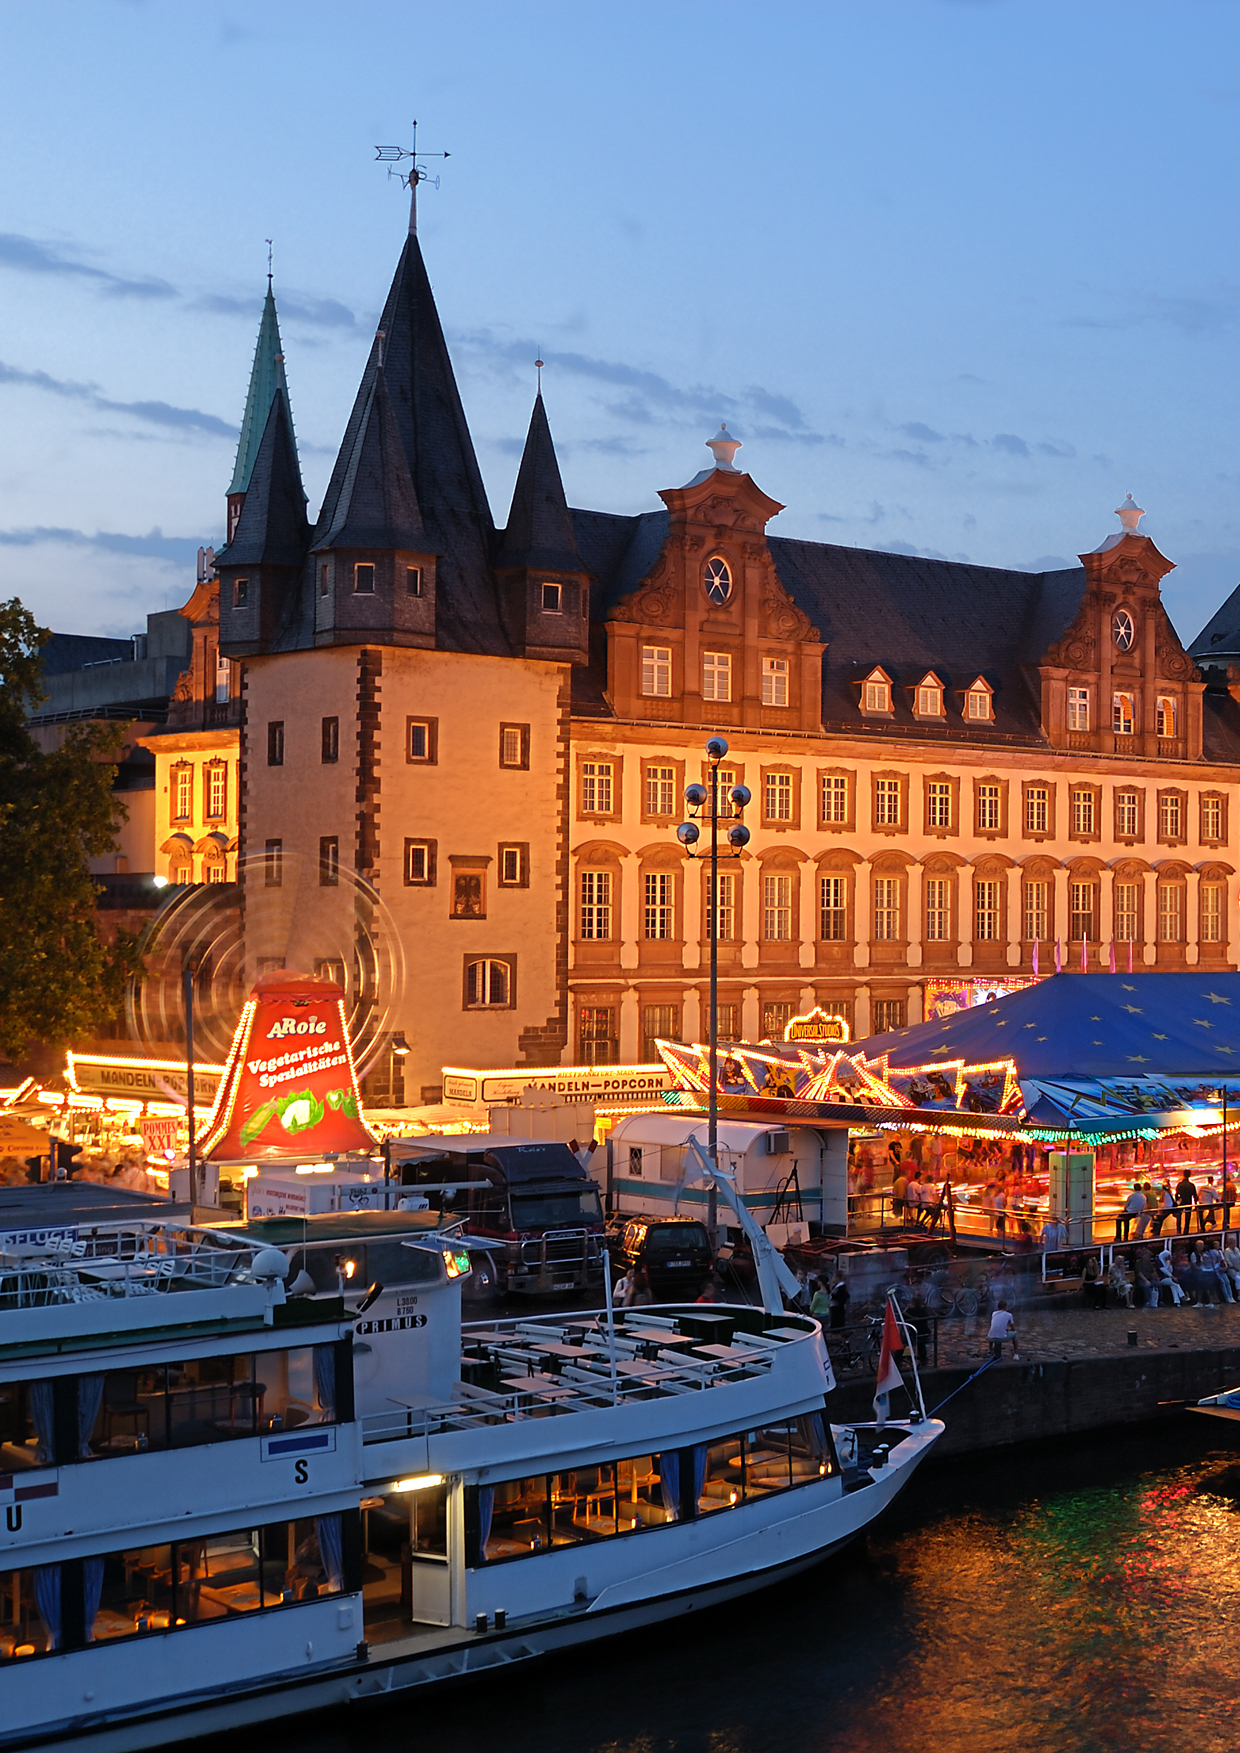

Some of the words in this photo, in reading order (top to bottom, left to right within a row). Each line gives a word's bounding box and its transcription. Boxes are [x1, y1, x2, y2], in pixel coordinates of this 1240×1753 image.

[247, 1041, 341, 1074] Vegetarische
[259, 1054, 347, 1087] Spezialitäten
[143, 1121, 176, 1136] POMMES
[148, 1135, 175, 1150] XXL
[361, 1315, 423, 1334] PRIMUS
[295, 1459, 308, 1484] S
[6, 1504, 22, 1532] U
